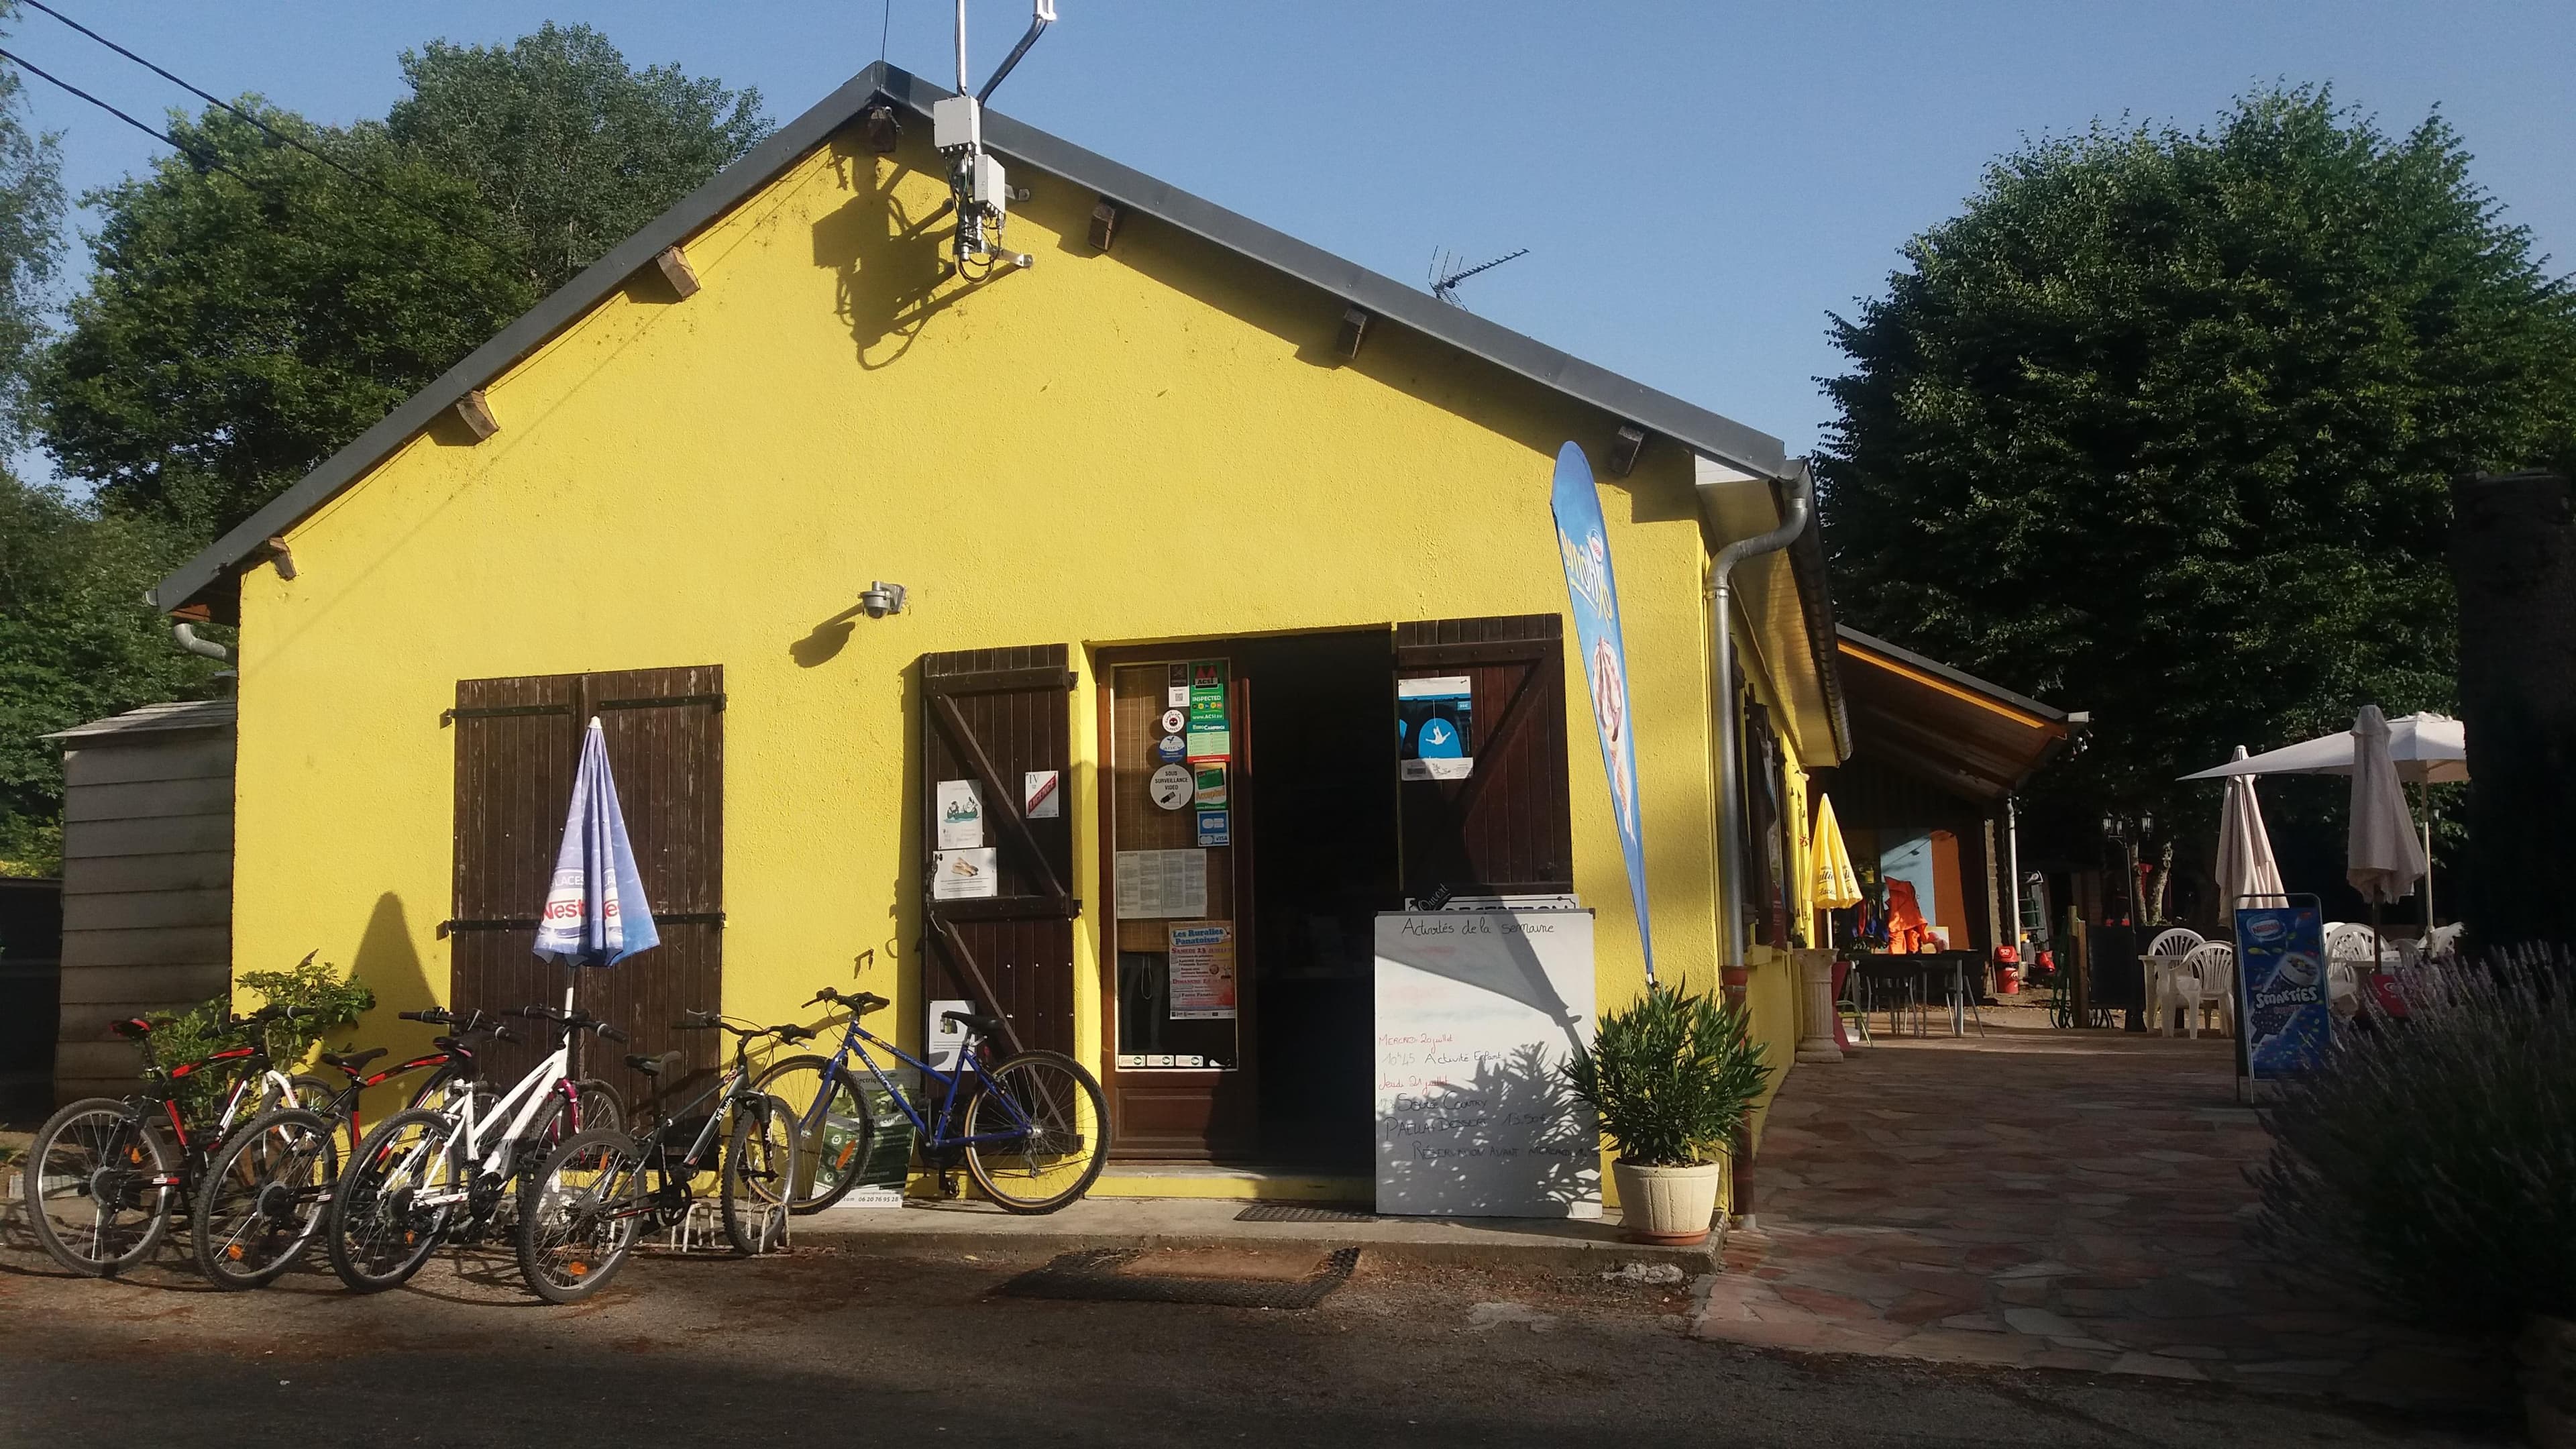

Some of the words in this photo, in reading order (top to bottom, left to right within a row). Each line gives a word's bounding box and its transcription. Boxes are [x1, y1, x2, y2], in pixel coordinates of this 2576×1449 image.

[1029, 774, 1040, 784] IV
[1029, 777, 1057, 810] LICENCE
[542, 898, 586, 920] Nest
[1173, 930, 1187, 938] Les
[1188, 928, 1224, 937] Ruralies
[1401, 917, 1454, 936] Activités
[1462, 918, 1476, 934] de
[1480, 916, 1491, 934] la
[1501, 922, 1555, 934] semaine
[1175, 936, 1220, 945] Panatoises
[1424, 1053, 1468, 1064] Activité
[1379, 1073, 1404, 1090] Jeudi
